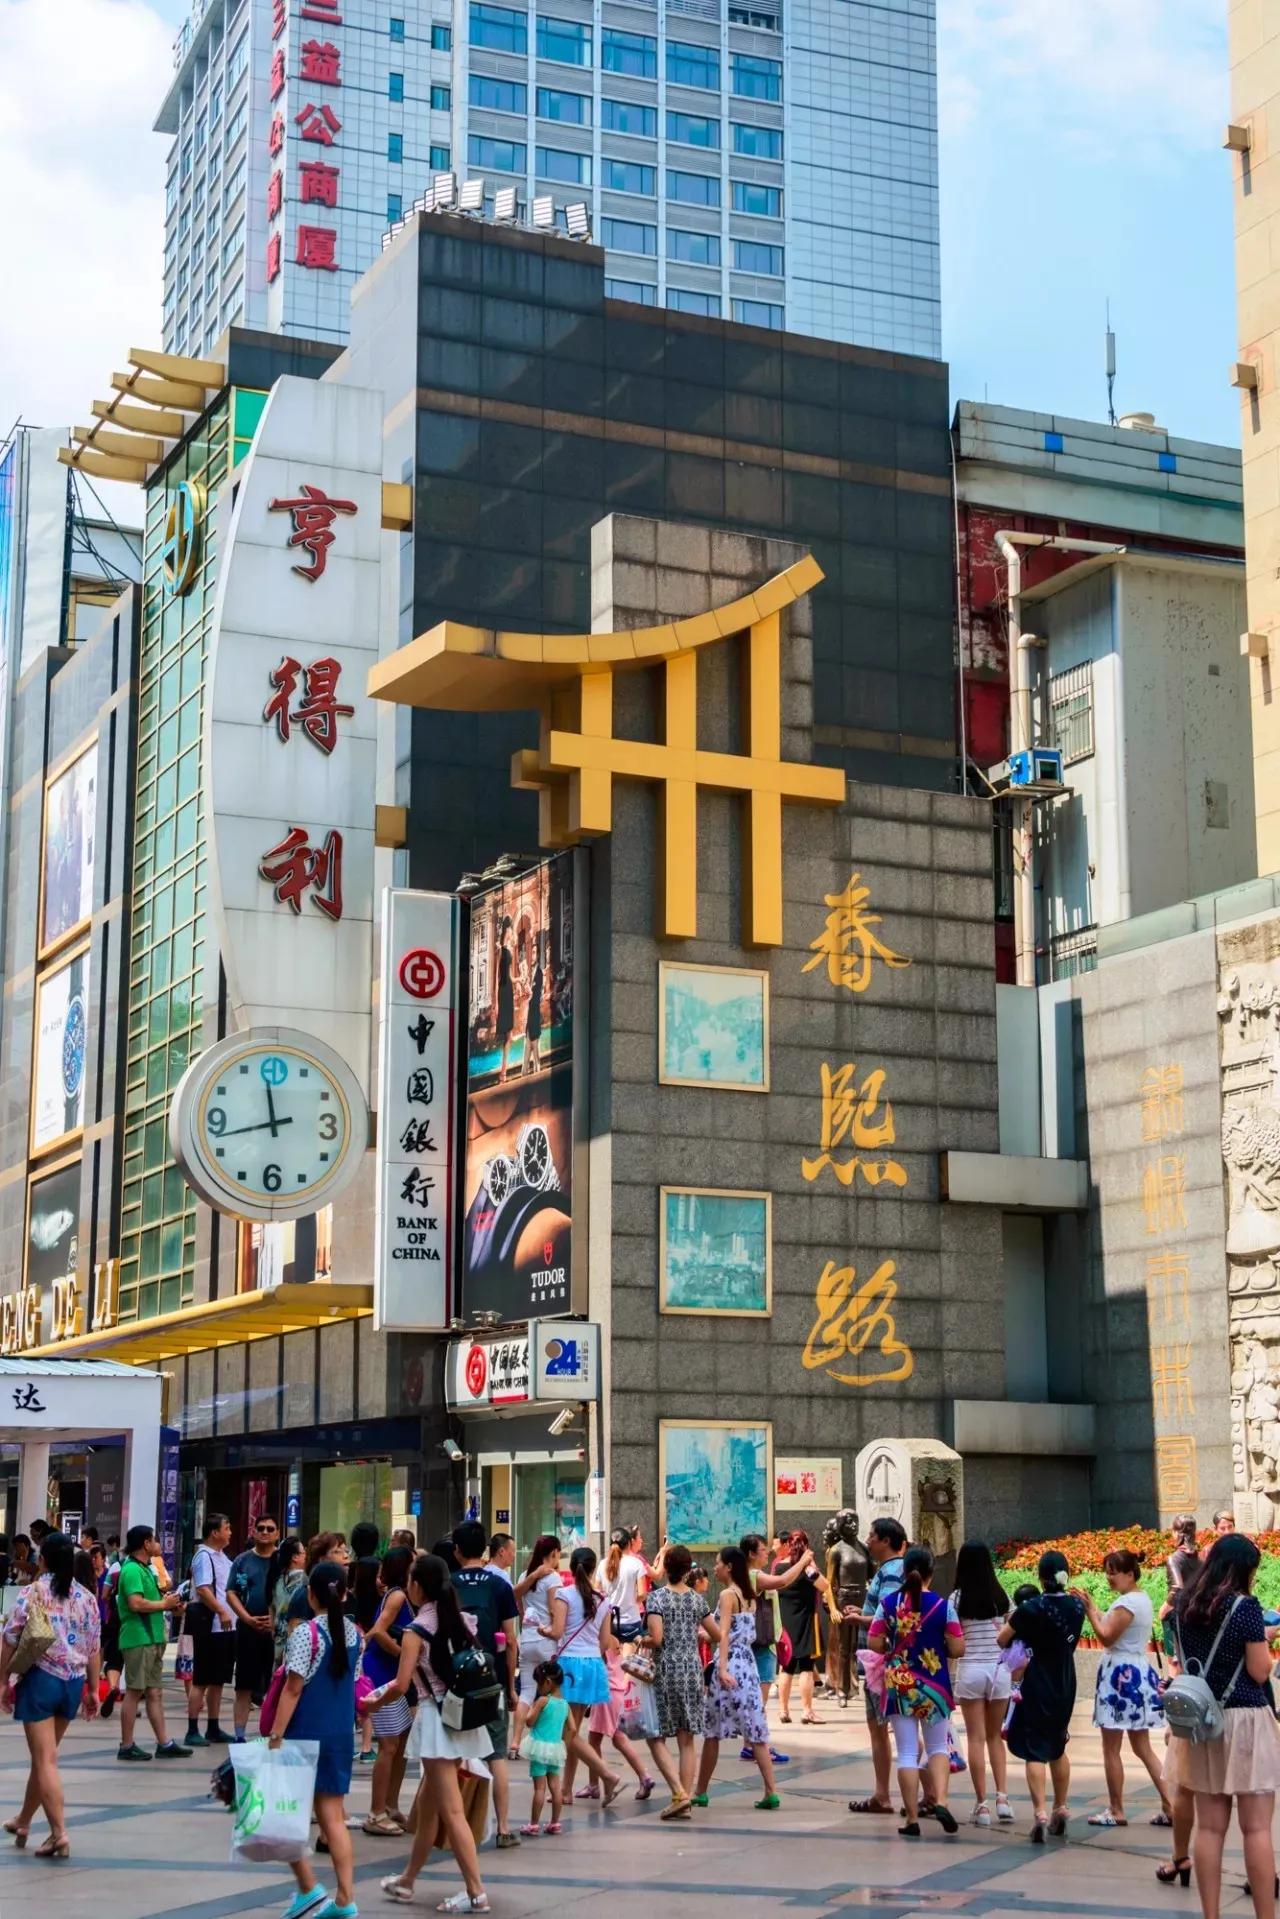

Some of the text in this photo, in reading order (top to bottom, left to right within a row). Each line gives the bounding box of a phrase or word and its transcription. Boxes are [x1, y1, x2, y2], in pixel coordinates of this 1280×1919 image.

[259, 485, 358, 922] 亨得利
[207, 1107, 227, 1136] 9
[318, 1112, 338, 1141] 3
[800, 873, 913, 1387] 春熙路
[262, 1164, 282, 1192] 6
[396, 1216, 438, 1230] BANK
[407, 1232, 427, 1245] OF
[392, 1247, 441, 1261] CHINA
[531, 1267, 565, 1288] TUDOR
[0, 1259, 117, 1355] ENG DE LI
[12, 1383, 47, 1413] 达
